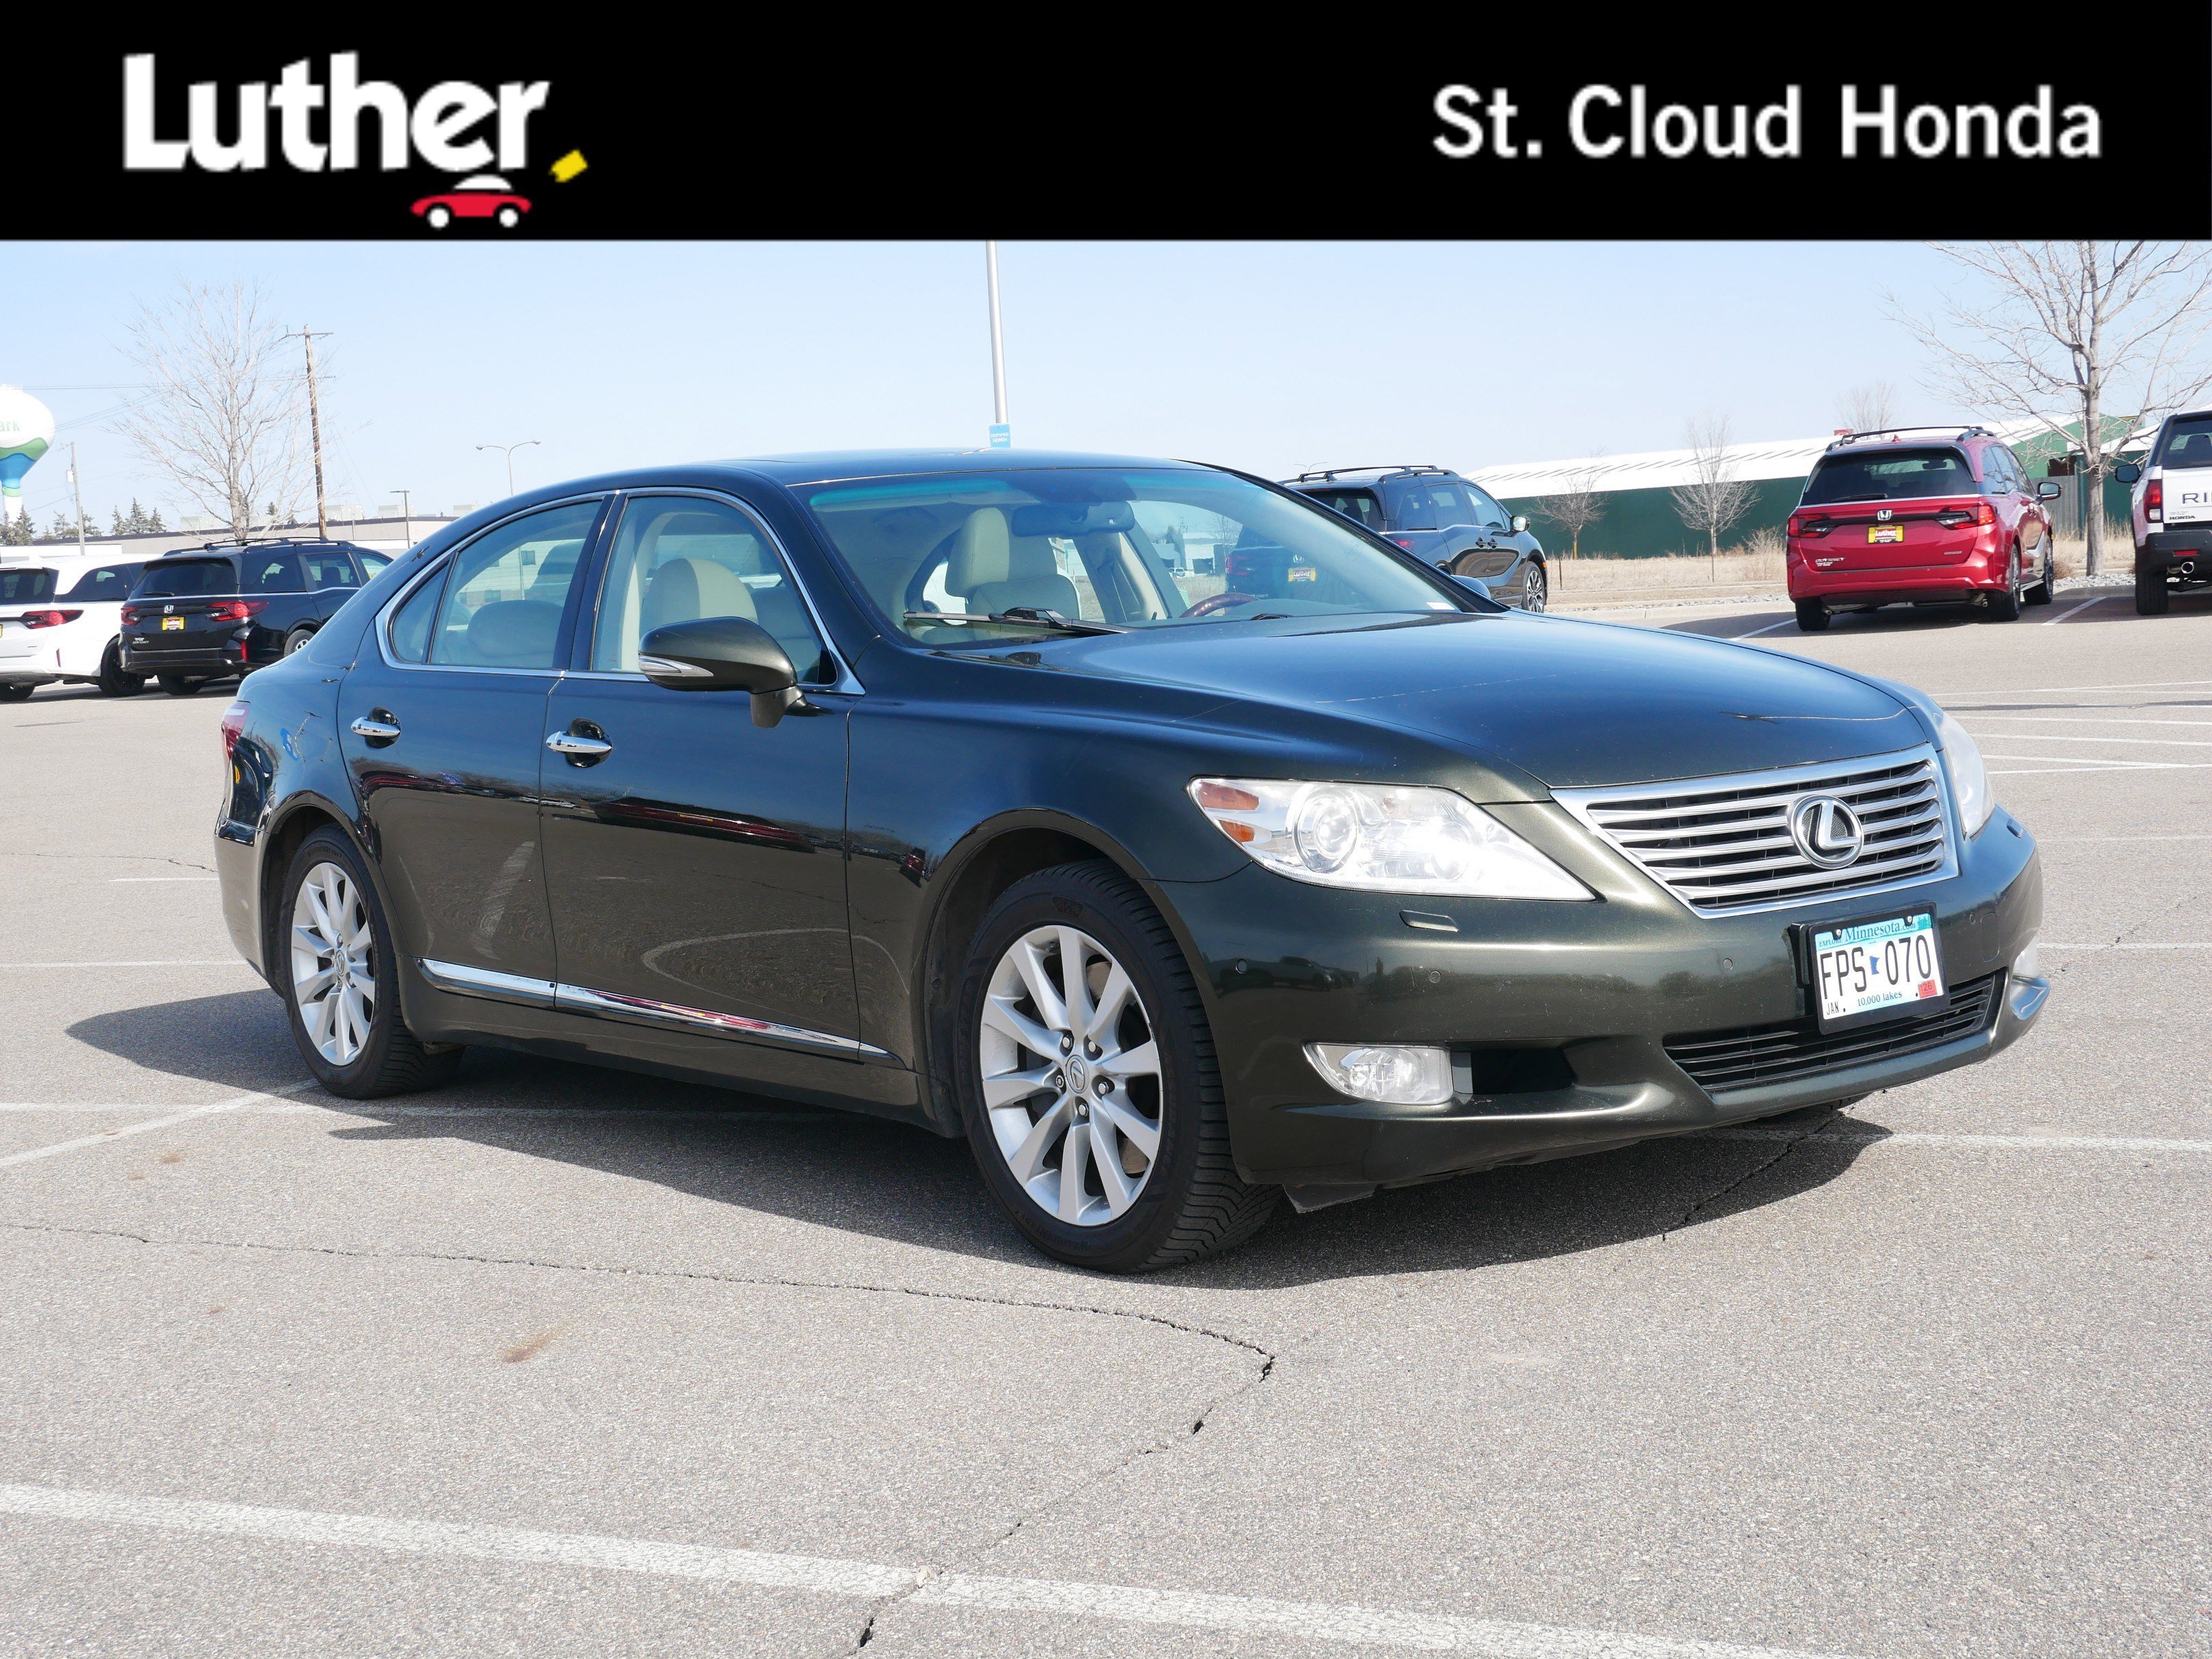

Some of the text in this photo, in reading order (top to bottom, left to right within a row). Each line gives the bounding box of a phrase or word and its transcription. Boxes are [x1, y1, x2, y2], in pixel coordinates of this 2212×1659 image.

[1820, 934, 1931, 1000] FPS 070
[1923, 982, 1932, 991] 26
[1857, 992, 1903, 1007] 10,000 lakes
[1827, 1001, 1840, 1016] JAN
